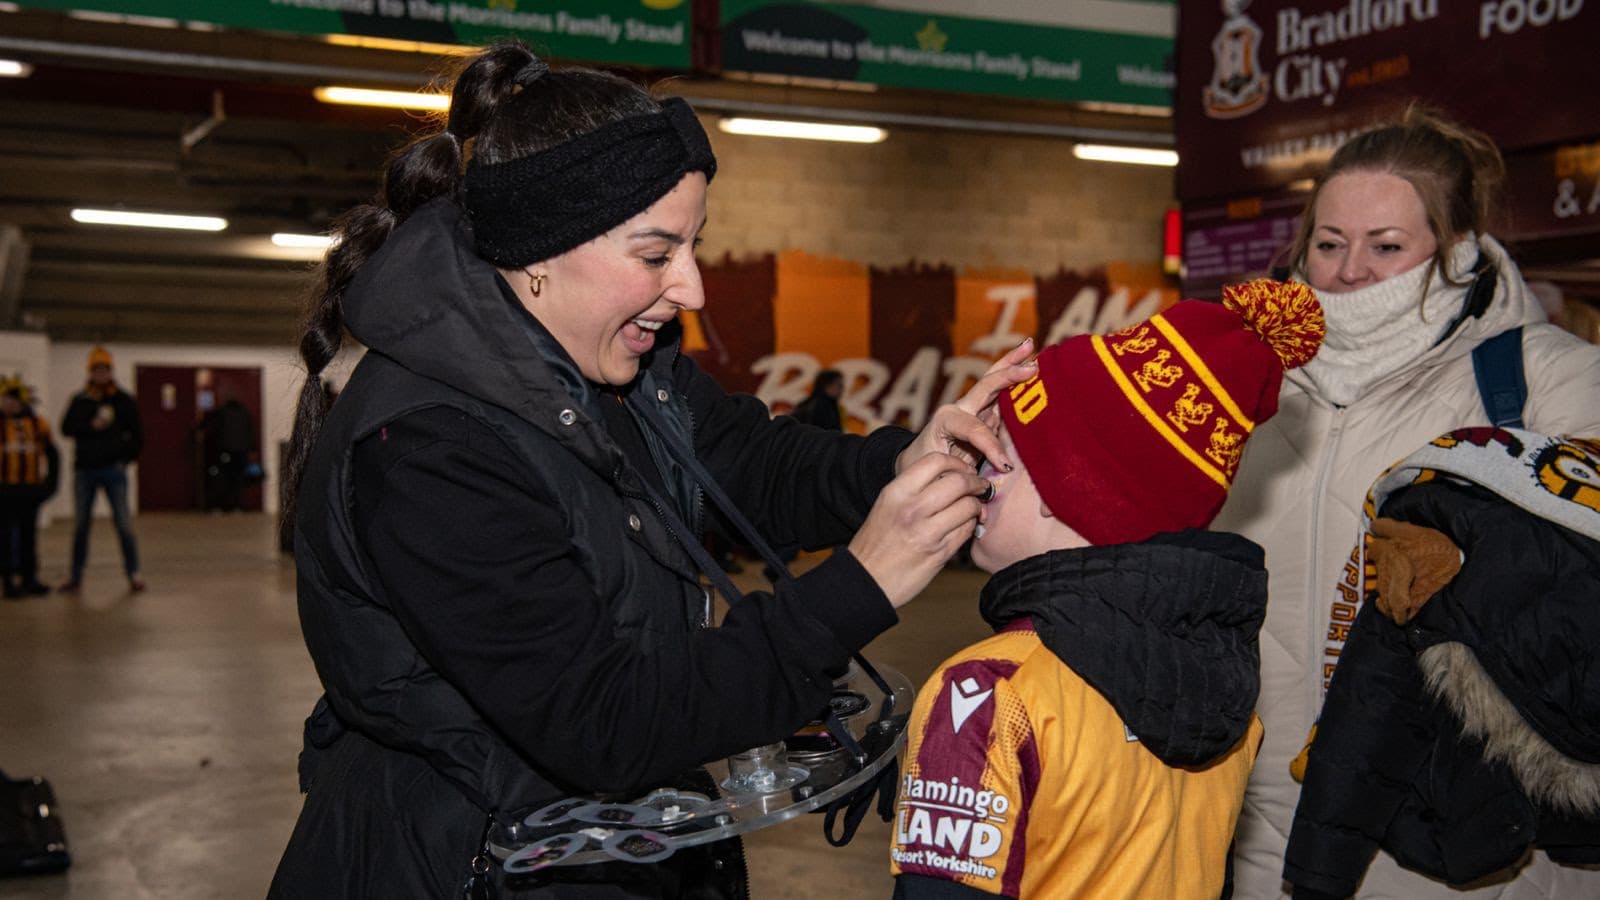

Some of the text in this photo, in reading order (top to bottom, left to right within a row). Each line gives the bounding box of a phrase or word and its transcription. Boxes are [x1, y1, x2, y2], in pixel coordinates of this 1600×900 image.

[449, 4, 554, 33] Morrisons
[556, 14, 622, 44] Family
[625, 18, 684, 45] Stand
[1478, 0, 1586, 39] FOOD
[742, 28, 1081, 81] Welcome to the Morrisons Family Stand
[1274, 54, 1348, 106] City
[1553, 178, 1581, 219] &
[971, 285, 1163, 355] I AM
[897, 808, 1002, 859] LAND
[925, 850, 997, 879] Yorkshire
